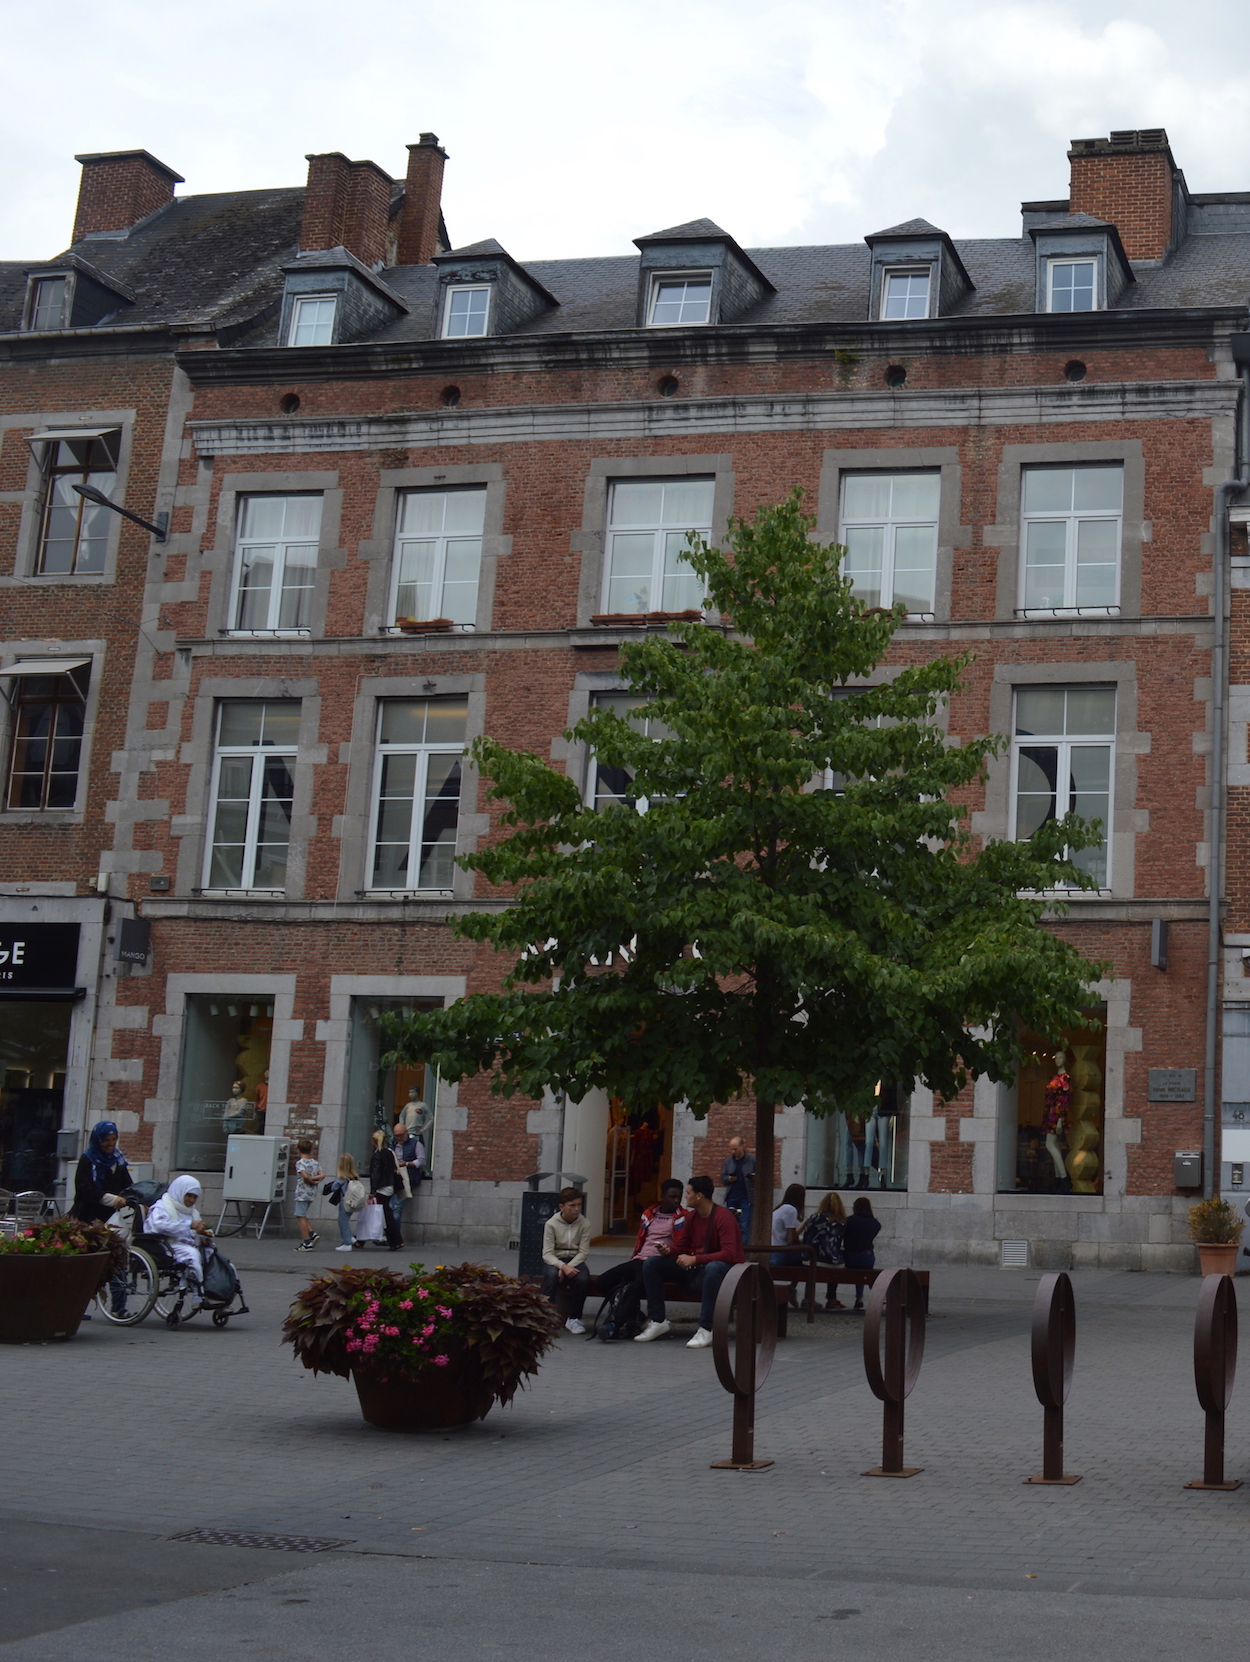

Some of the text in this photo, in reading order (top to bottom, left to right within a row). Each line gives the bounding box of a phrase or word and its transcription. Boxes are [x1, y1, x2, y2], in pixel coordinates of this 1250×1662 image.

[121, 950, 145, 960] MANGO
[0, 971, 13, 979] IS
[1232, 1109, 1245, 1120] 48
